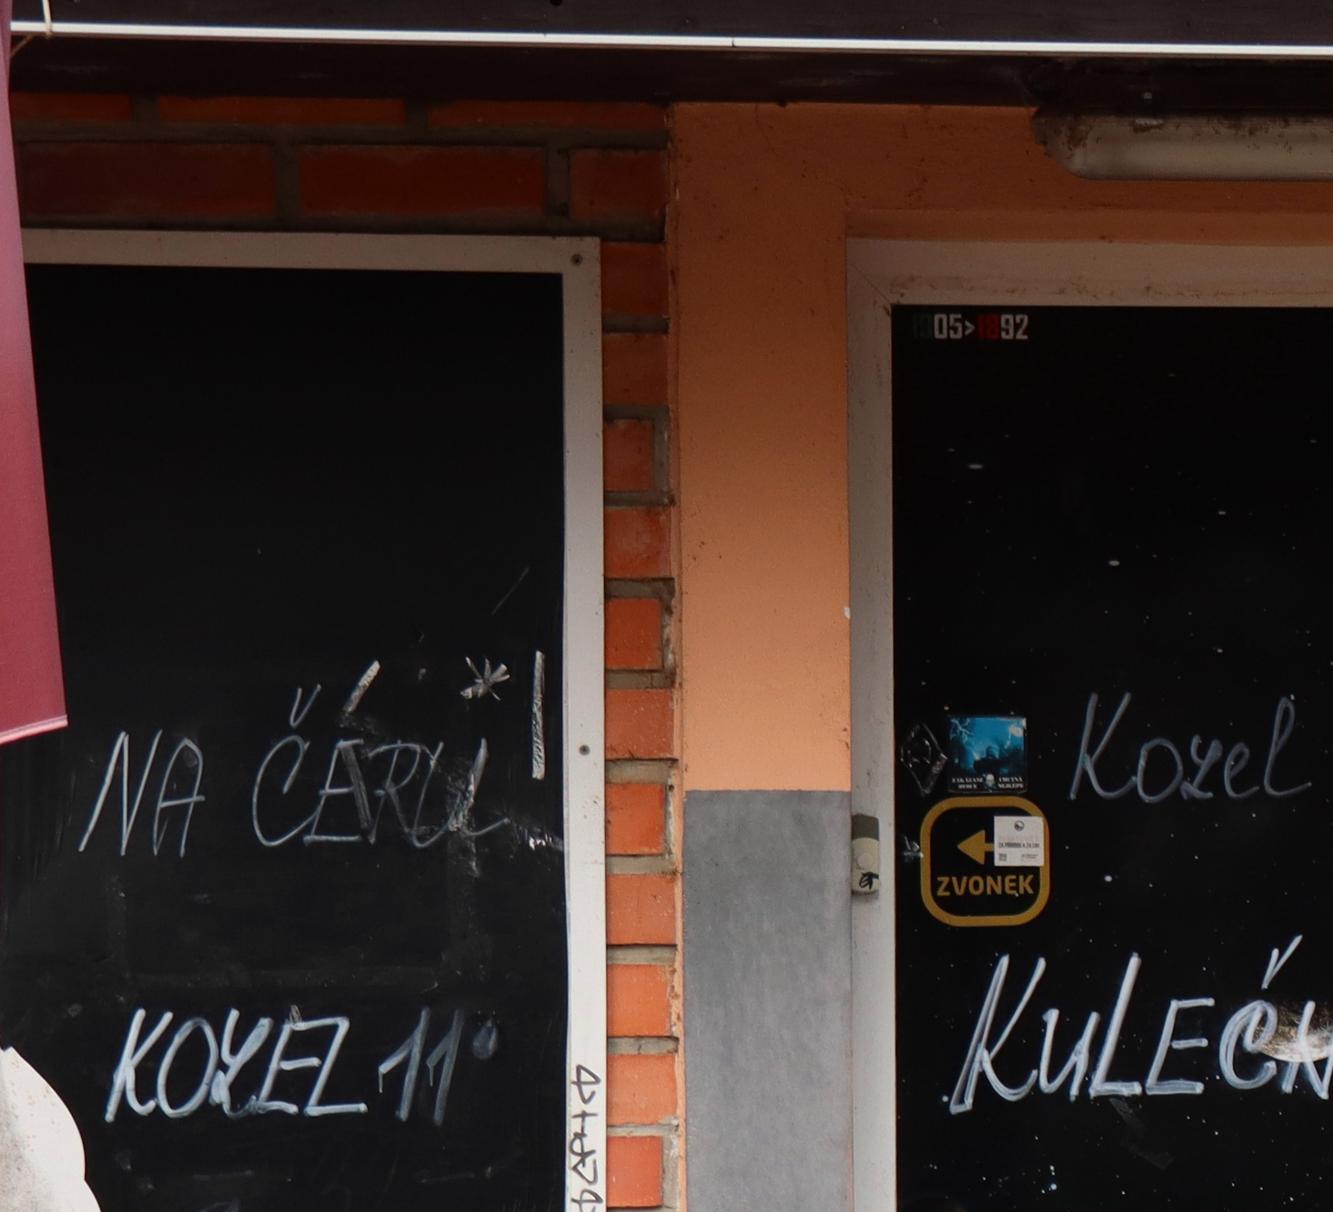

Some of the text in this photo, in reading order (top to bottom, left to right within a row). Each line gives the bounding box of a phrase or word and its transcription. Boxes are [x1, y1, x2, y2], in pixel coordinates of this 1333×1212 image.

[78, 730, 206, 857] NA
[937, 874, 1034, 897] ZVONEK
[105, 1006, 369, 1123] KOZEL
